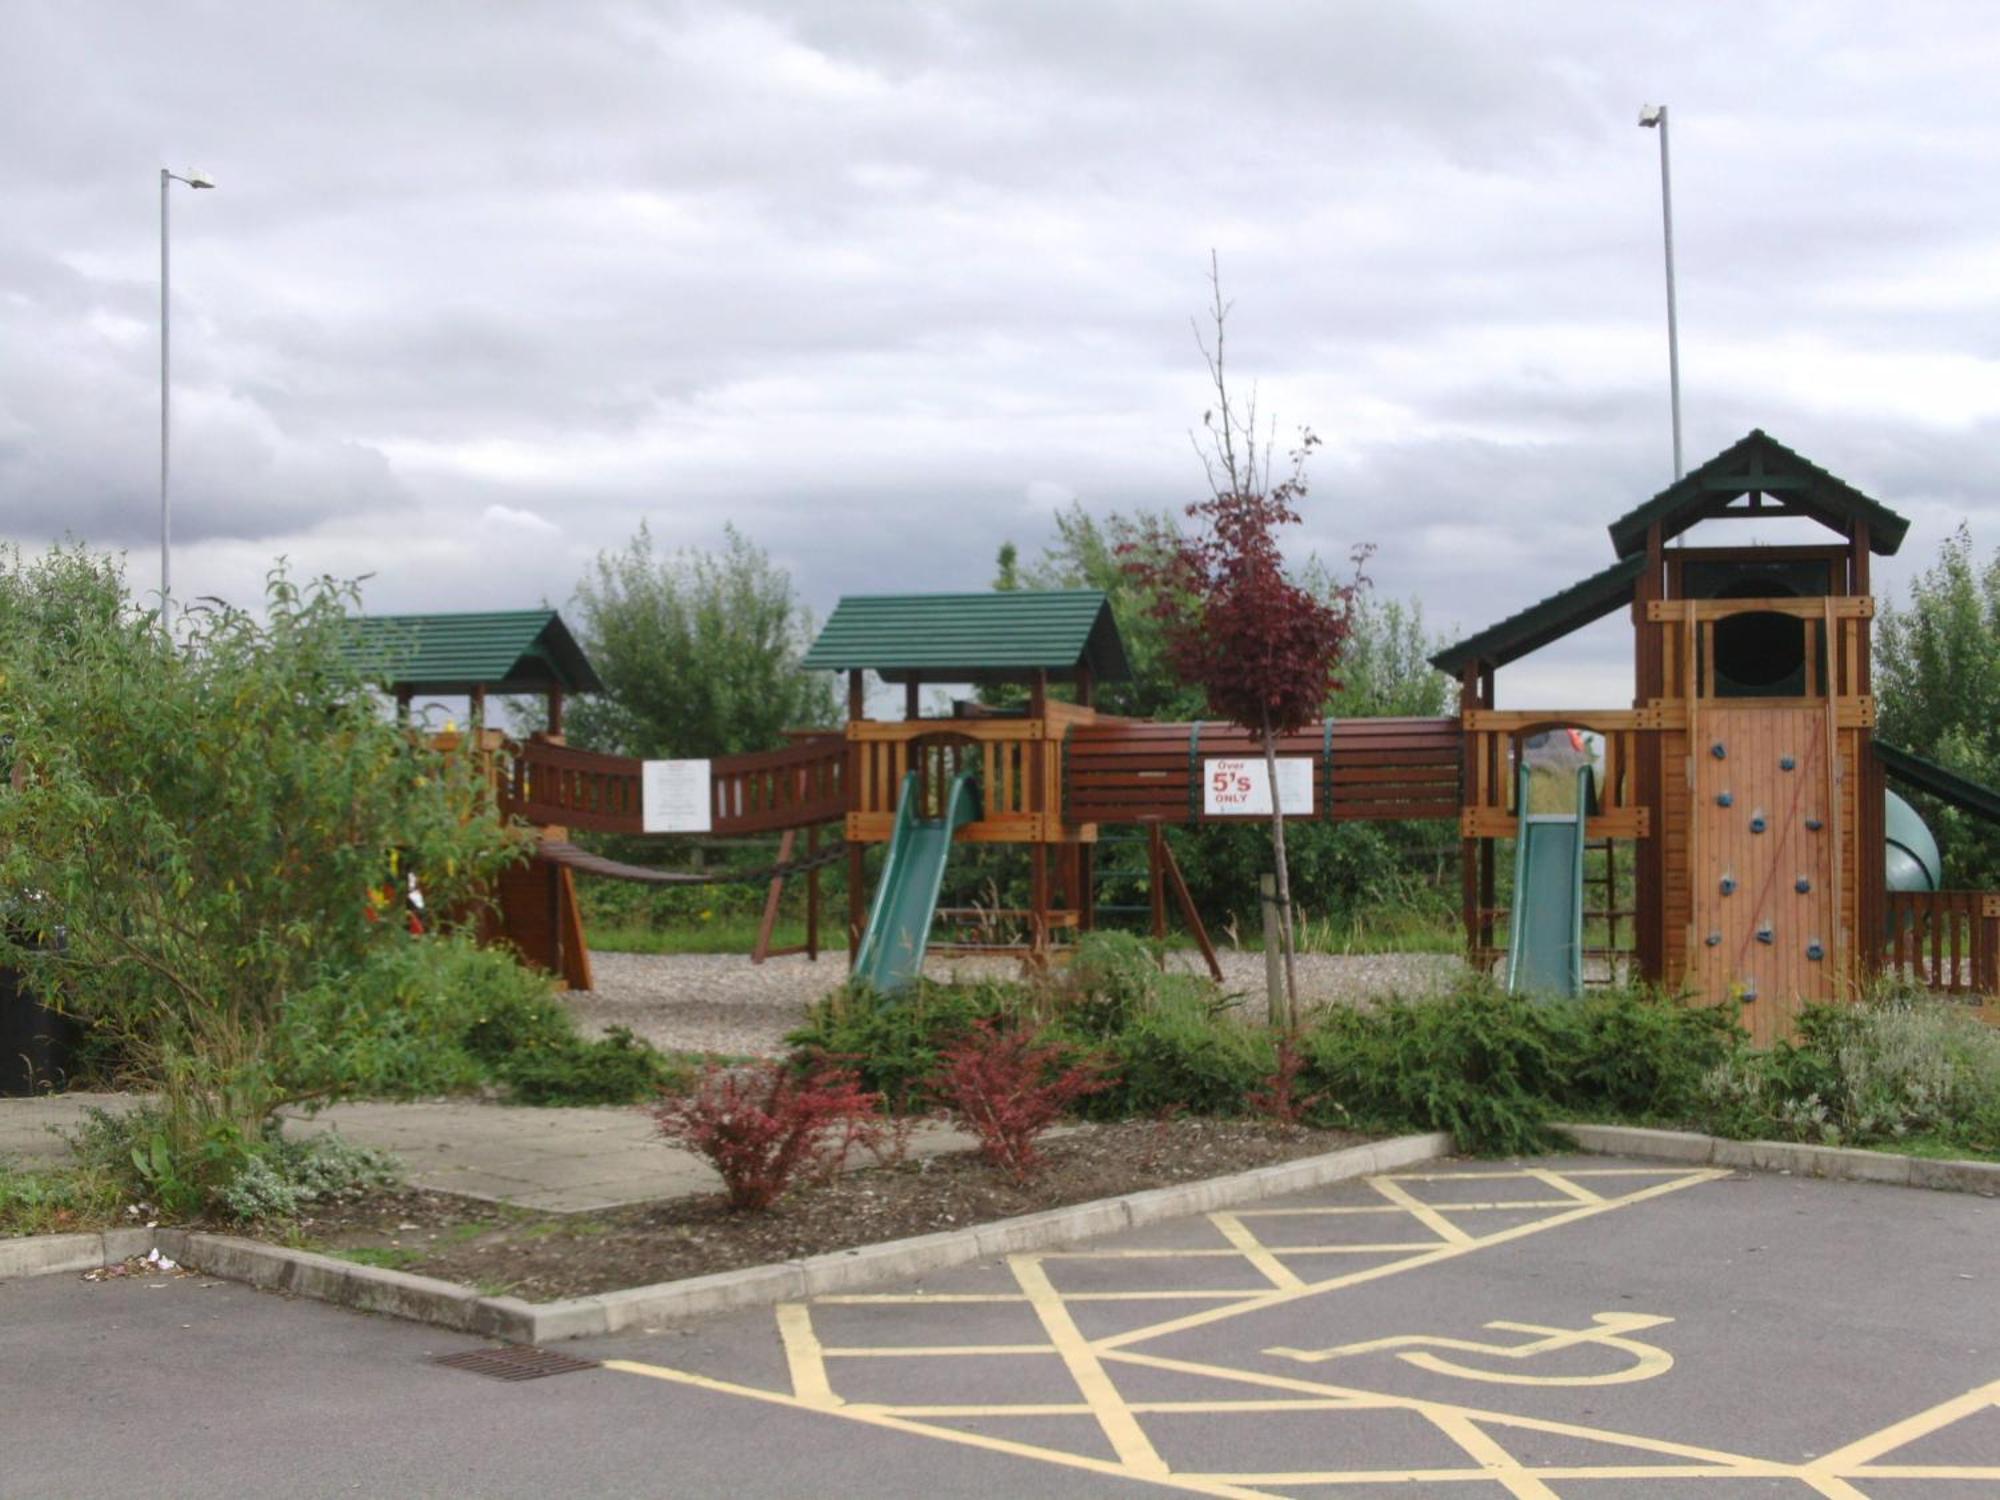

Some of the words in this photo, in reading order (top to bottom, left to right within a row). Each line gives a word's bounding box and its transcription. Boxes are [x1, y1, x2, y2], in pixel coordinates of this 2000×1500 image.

[1217, 760, 1244, 770] Over
[1213, 772, 1251, 792] 5's
[1215, 794, 1248, 803] ONLY
